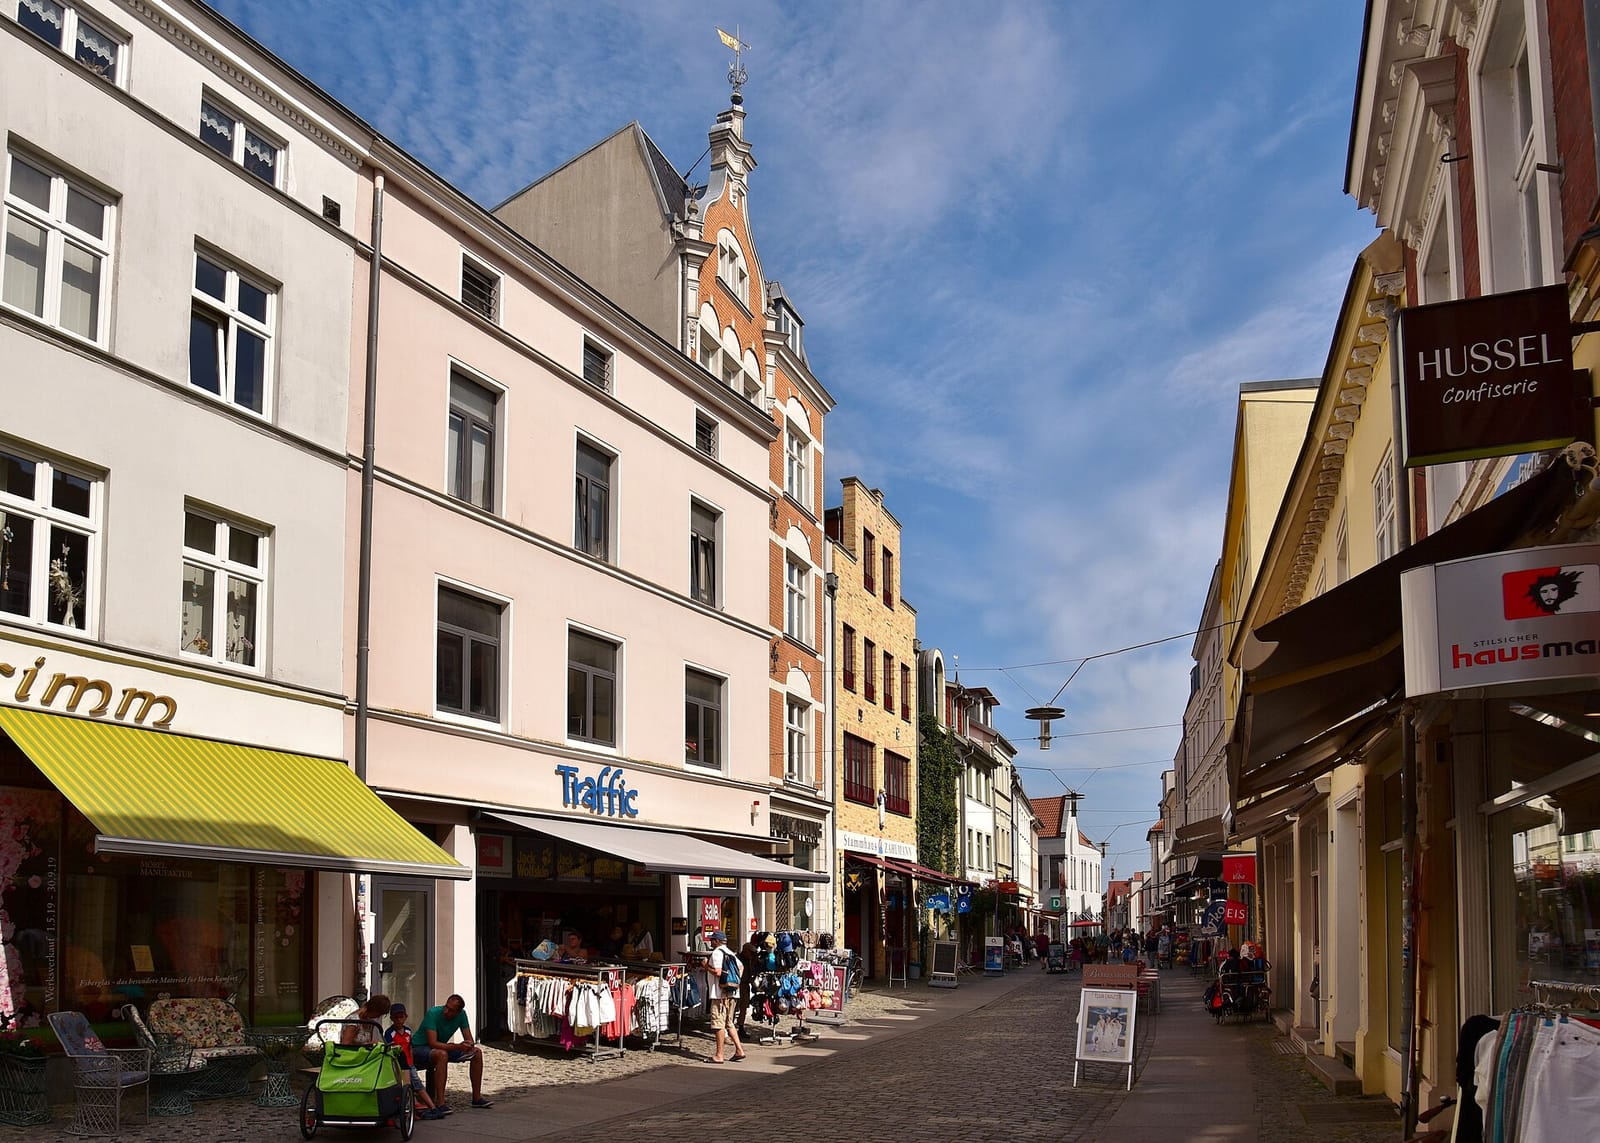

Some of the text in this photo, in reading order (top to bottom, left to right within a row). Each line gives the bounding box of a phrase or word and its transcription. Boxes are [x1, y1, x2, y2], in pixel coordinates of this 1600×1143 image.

[1418, 333, 1564, 381] HUSSEL
[1442, 379, 1538, 404] Confiserie
[1452, 639, 1600, 669] hausma
[1473, 633, 1539, 648] STILSICHER
[555, 764, 639, 817] Traffic
[843, 833, 878, 851] Stammhaus
[46, 902, 56, 933] 1.5.19
[1227, 908, 1246, 919] EIS
